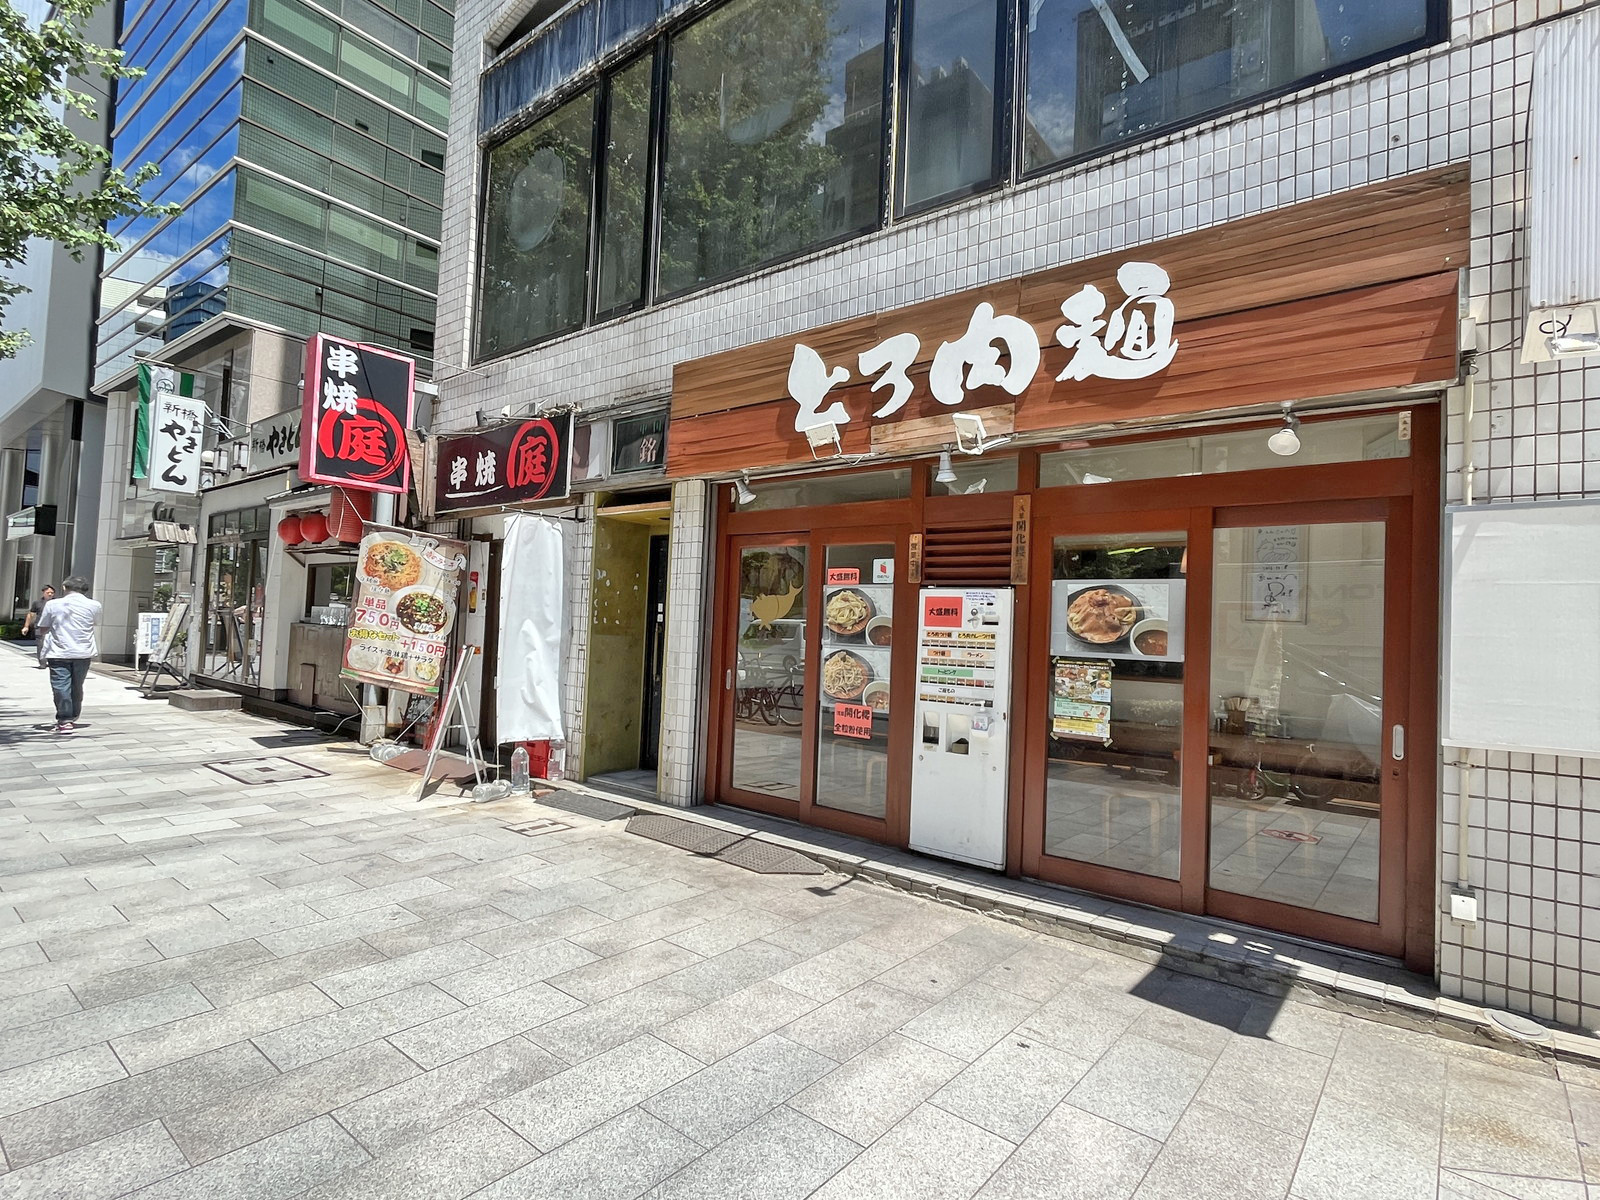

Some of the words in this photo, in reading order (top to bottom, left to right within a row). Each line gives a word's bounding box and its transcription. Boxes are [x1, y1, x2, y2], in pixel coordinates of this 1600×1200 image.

[322, 345, 359, 415] 串焼
[163, 402, 198, 420] 新橋
[160, 420, 198, 486] やきとん
[337, 415, 387, 466] 庭
[450, 450, 497, 490] 串焼
[516, 436, 548, 486] 庭
[829, 572, 858, 582] 大盛無料
[364, 596, 386, 610] 単品
[928, 608, 959, 617] 大盛無料
[356, 608, 400, 630] 750円
